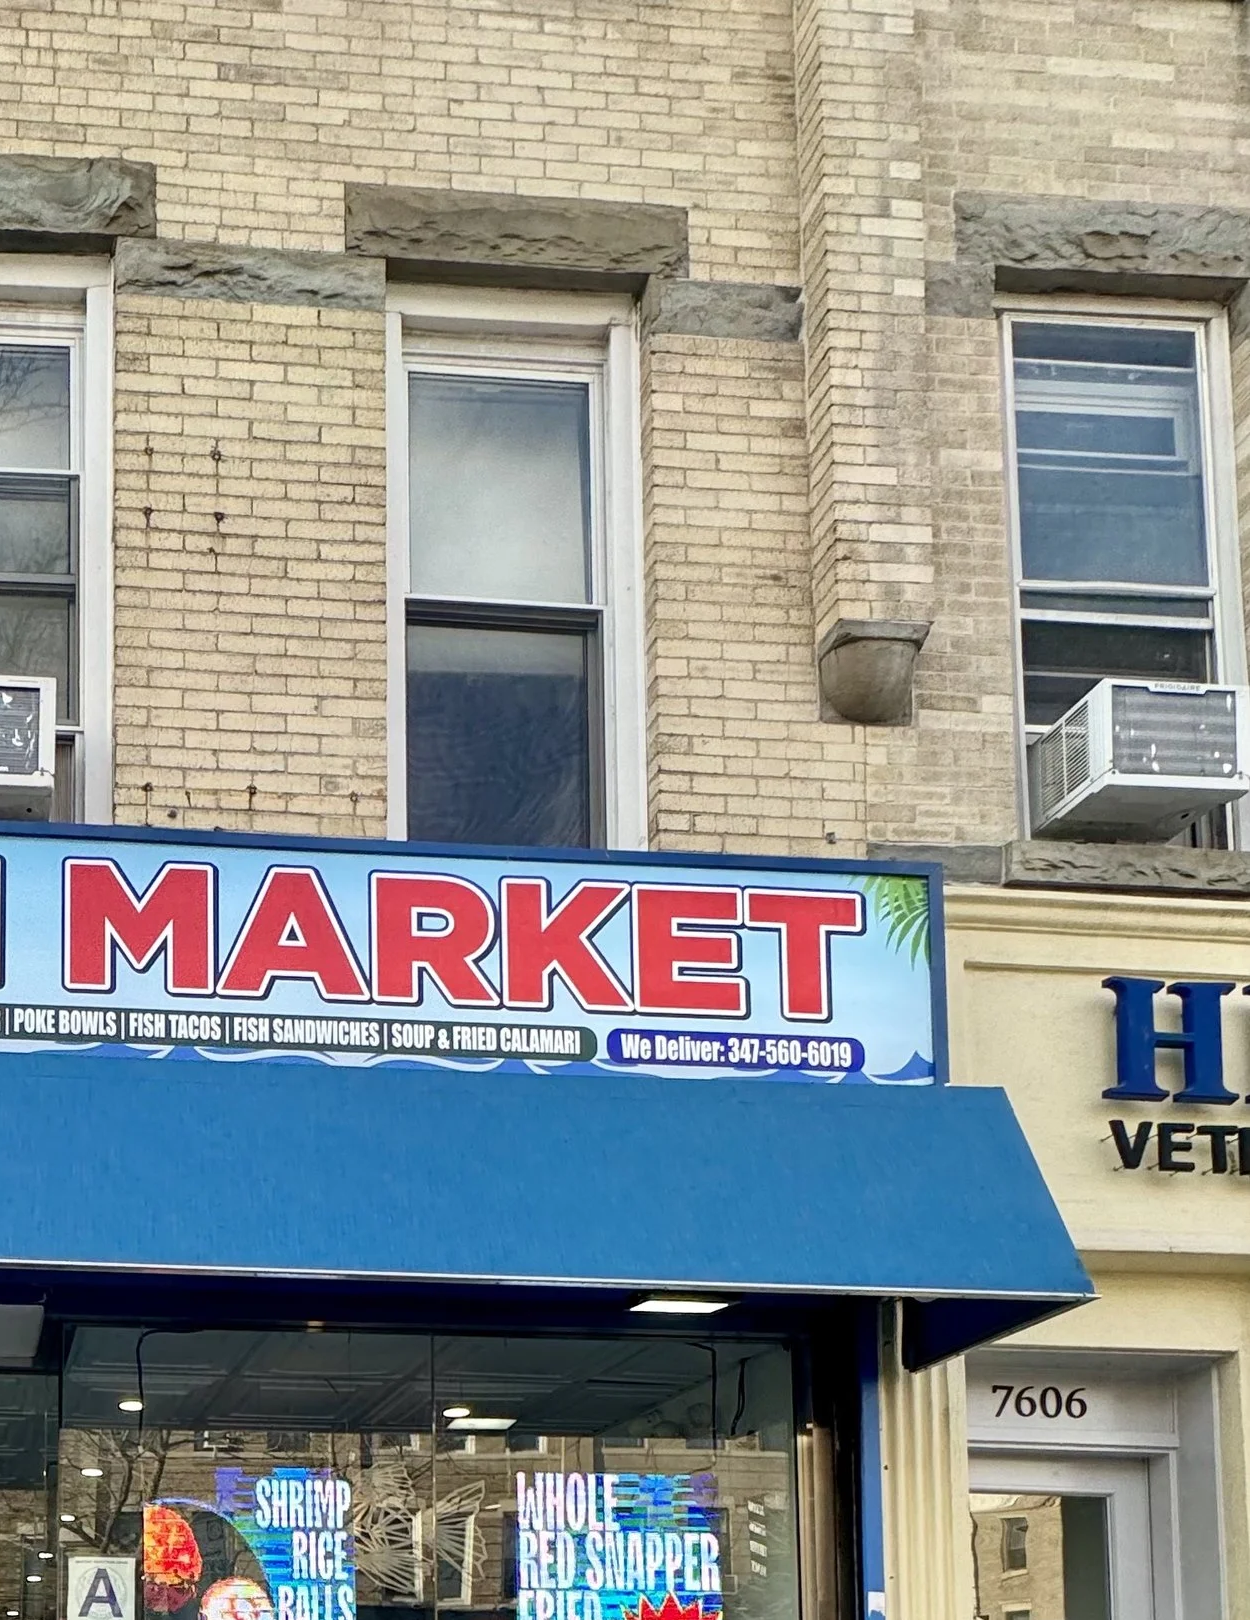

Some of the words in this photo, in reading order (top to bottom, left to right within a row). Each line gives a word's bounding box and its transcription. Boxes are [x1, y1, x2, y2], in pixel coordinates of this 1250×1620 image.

[1154, 683, 1201, 691] FRIGIDAIRE
[62, 857, 865, 1021] MARKET
[13, 1008, 55, 1034] POKE
[58, 1009, 117, 1036] BOWLS
[129, 1012, 165, 1038] FISH
[168, 1014, 222, 1041] TACOS
[234, 1017, 269, 1042] FISH
[273, 1018, 380, 1047] SANDWICHES
[392, 1023, 435, 1049] SOUP
[437, 1028, 450, 1050] &
[453, 1025, 497, 1051] FRIED
[500, 1027, 581, 1055] CALAMARI
[620, 1034, 652, 1060] We
[655, 1035, 726, 1063] Deliver:
[727, 1037, 852, 1068] 347-560-6019
[1102, 976, 1250, 1106] H
[991, 1385, 1088, 1419] 7606
[254, 1479, 351, 1529] SHRIMP
[516, 1472, 620, 1531] WHOLE
[292, 1531, 347, 1580] RICE
[518, 1531, 576, 1589] RED
[586, 1531, 722, 1591] SNAPPER
[78, 1568, 123, 1618] A
